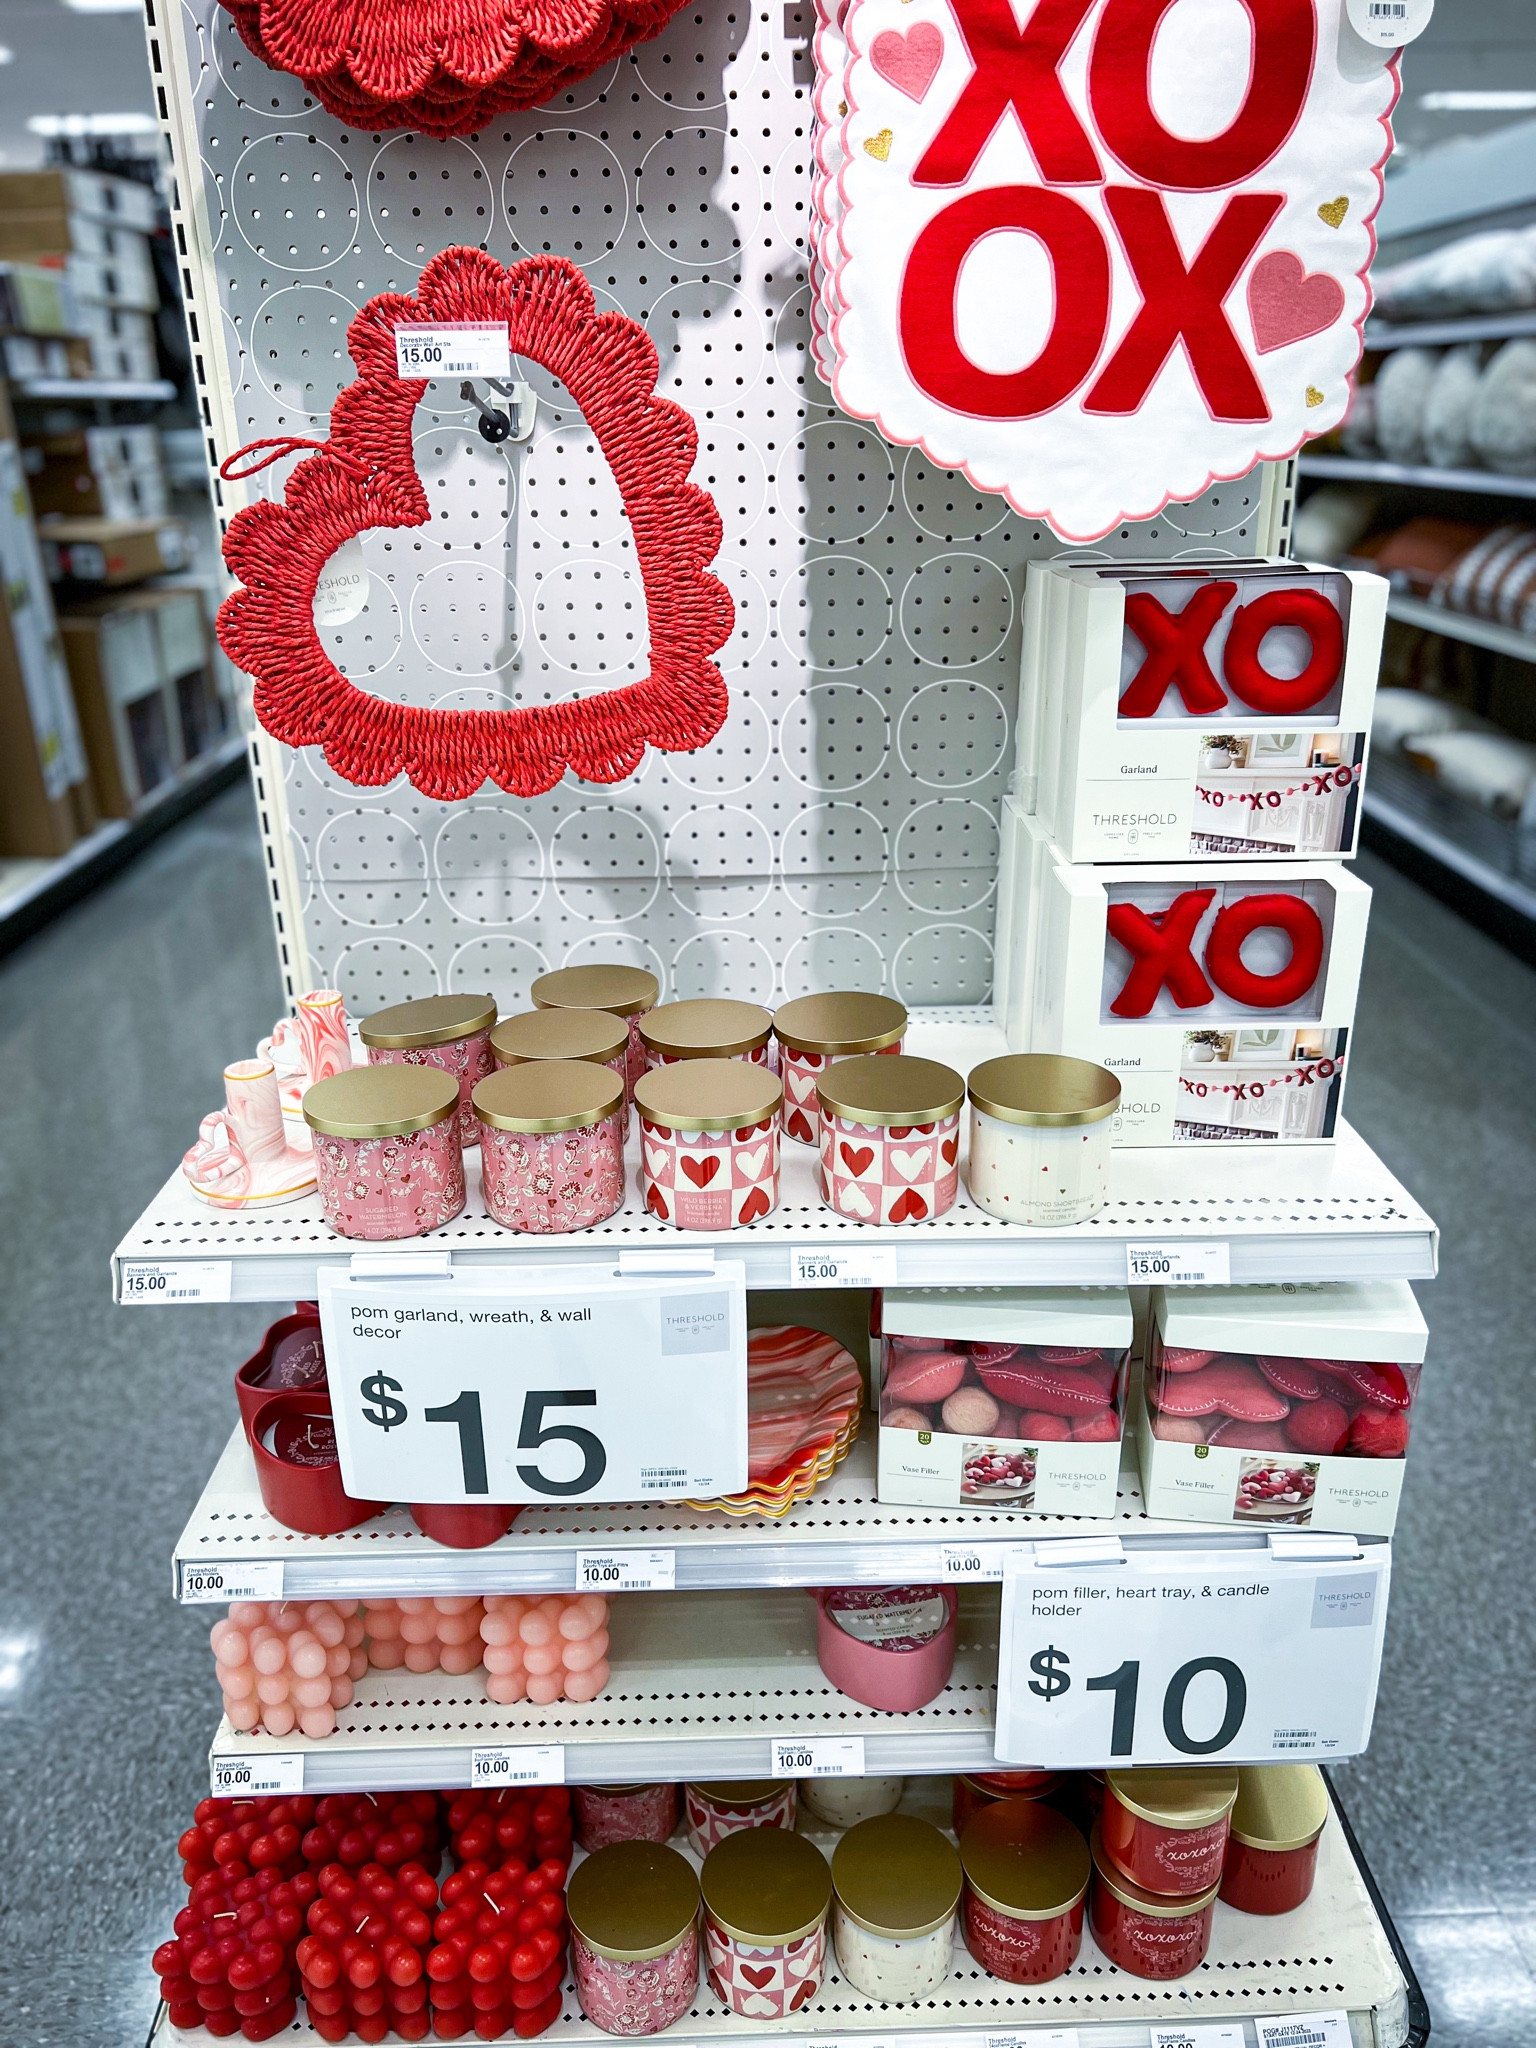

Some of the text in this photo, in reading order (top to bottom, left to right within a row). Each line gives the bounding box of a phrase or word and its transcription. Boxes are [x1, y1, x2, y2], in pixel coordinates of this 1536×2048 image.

[897, 184, 1287, 423] OX
[401, 348, 442, 363] 15.00
[315, 574, 360, 591] ESHOLD
[1120, 765, 1158, 774] Garland
[1092, 814, 1177, 826] THRESHOLD
[1104, 1058, 1142, 1066] Garland
[1113, 1102, 1161, 1114] SHOLD
[1020, 1194, 1094, 1208] ALMOND SHORTBREAD
[359, 1212, 408, 1220] WATERMELON
[365, 1206, 399, 1214] SUGARED
[127, 1266, 160, 1274] Threshold
[798, 1264, 838, 1278] 15.00
[1131, 1260, 1171, 1274] 15.00
[126, 1276, 167, 1291] 15.00
[351, 1306, 592, 1325] pom garland, wreath, & wall
[666, 1312, 725, 1325] THRESHOLD
[353, 1324, 402, 1339] decor
[902, 1465, 940, 1476] Vase Filler
[1048, 1472, 1107, 1482] THRESHOLD
[1174, 1479, 1216, 1490] Vase Filler
[1328, 1488, 1389, 1499] THRESHOLD
[945, 1557, 981, 1571] 10.00
[187, 1567, 218, 1575] Threshold
[583, 1568, 620, 1582] 10.00
[187, 1576, 223, 1590] 10.00
[1032, 1584, 1270, 1601] pom filler, heart tray, & candle
[1319, 1592, 1372, 1602] THRESHOLD
[1031, 1603, 1082, 1616] holder
[474, 1752, 503, 1760] Threshold
[778, 1754, 813, 1768] 10.00
[216, 1761, 245, 1769] Threshold
[475, 1760, 509, 1775] 10.00
[216, 1770, 251, 1785] 10.00
[1166, 1836, 1226, 1861] xoxoxo
[973, 1915, 1031, 1949] xoxoxo
[1133, 1930, 1197, 1943] xoxoxo
[988, 2036, 1017, 2045] Threshold
[1156, 2033, 1186, 2041] Threshold
